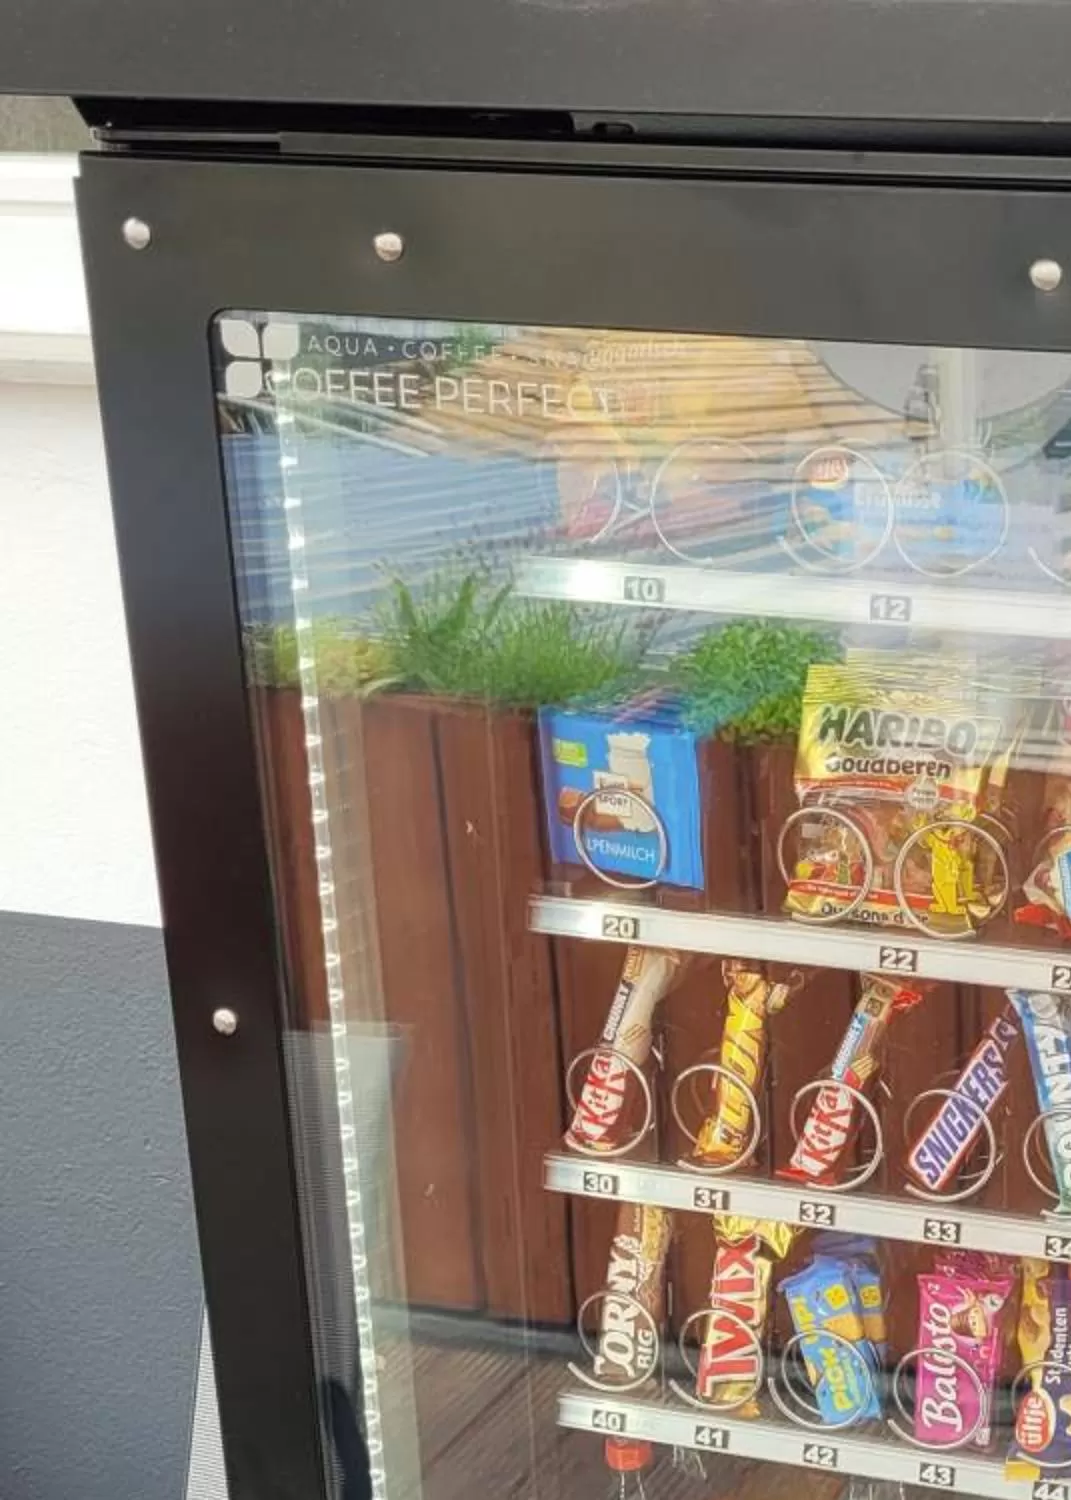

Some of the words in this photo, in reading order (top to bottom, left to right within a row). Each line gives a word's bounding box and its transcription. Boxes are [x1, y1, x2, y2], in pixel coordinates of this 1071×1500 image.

[307, 336, 377, 357] AQUA
[402, 340, 502, 363] COFFEE
[264, 368, 420, 409] COFFEE
[435, 376, 617, 420] PERFECT
[627, 577, 660, 598] 10
[873, 600, 907, 620] 12
[817, 704, 978, 757] HARIBO
[584, 837, 656, 863] LPENMILCH
[604, 918, 635, 938] 20
[881, 949, 914, 970] 22
[914, 1044, 1005, 1182] SNICKERS
[584, 1172, 613, 1192] 30
[695, 1190, 725, 1208] 31
[802, 1204, 832, 1223] 32
[925, 1221, 958, 1241] 33
[697, 1235, 761, 1397] TWIX
[637, 1329, 654, 1370] BIG
[1044, 1307, 1068, 1385] Stdenten
[921, 1302, 963, 1433] Balisto
[593, 1412, 621, 1430] 40
[1019, 1397, 1045, 1446] ültje
[695, 1427, 725, 1447] 41
[804, 1446, 834, 1464] 42
[921, 1465, 952, 1484] 43
